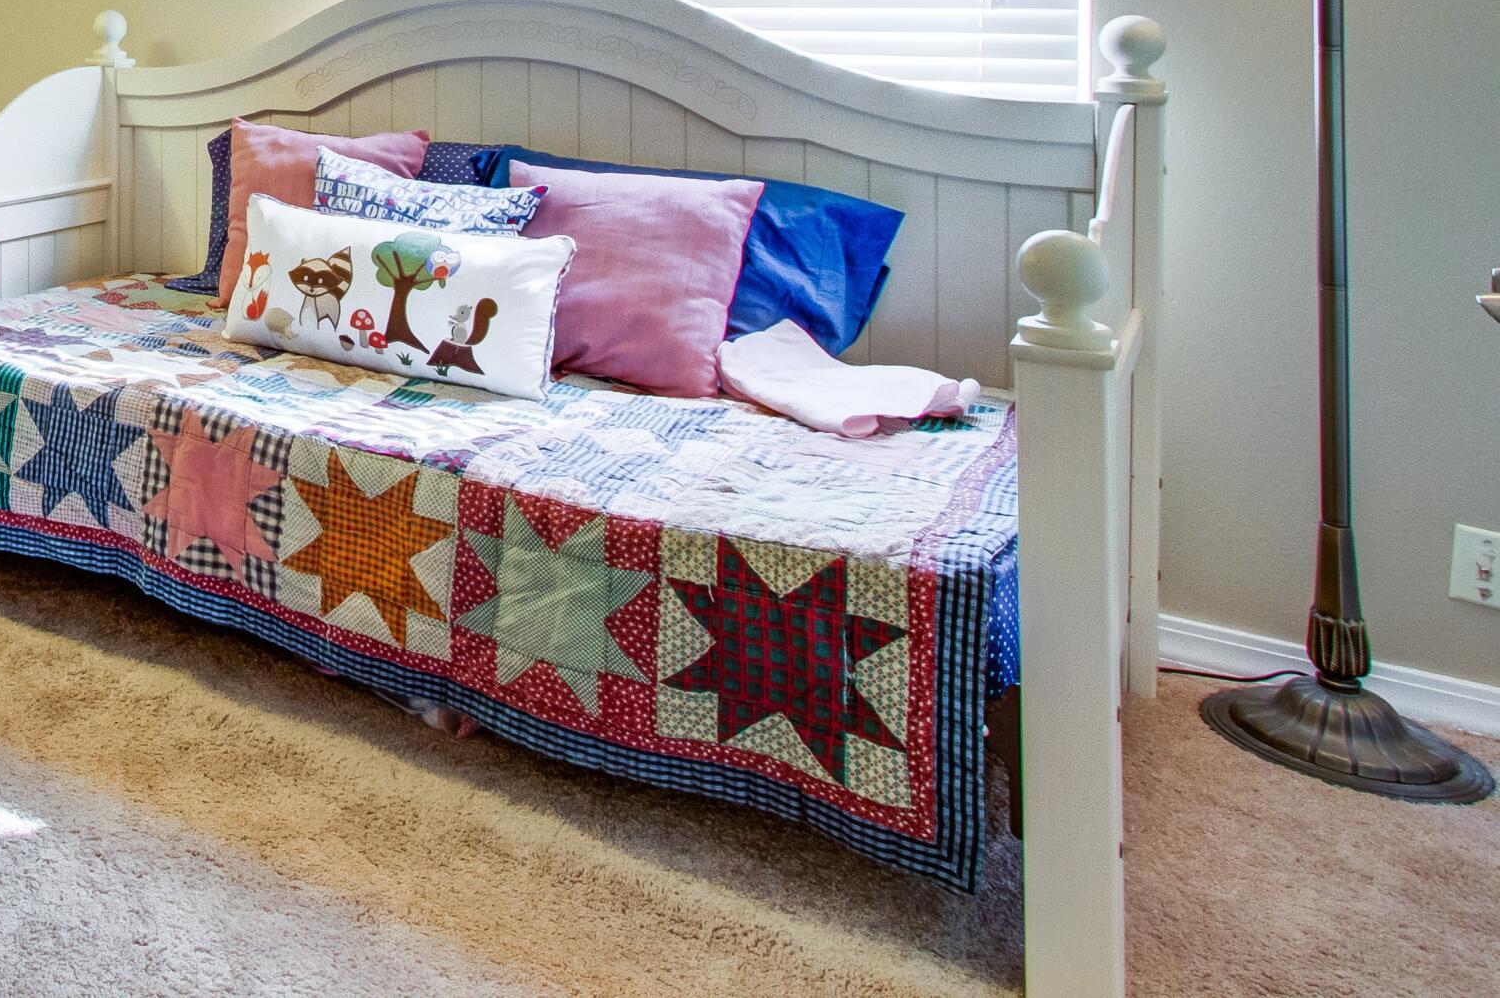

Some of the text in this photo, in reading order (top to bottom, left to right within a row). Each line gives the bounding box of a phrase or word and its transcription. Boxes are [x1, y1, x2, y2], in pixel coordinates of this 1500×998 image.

[336, 182, 388, 206] BRAVE
[327, 196, 363, 213] LAND
[364, 204, 389, 220] OF
